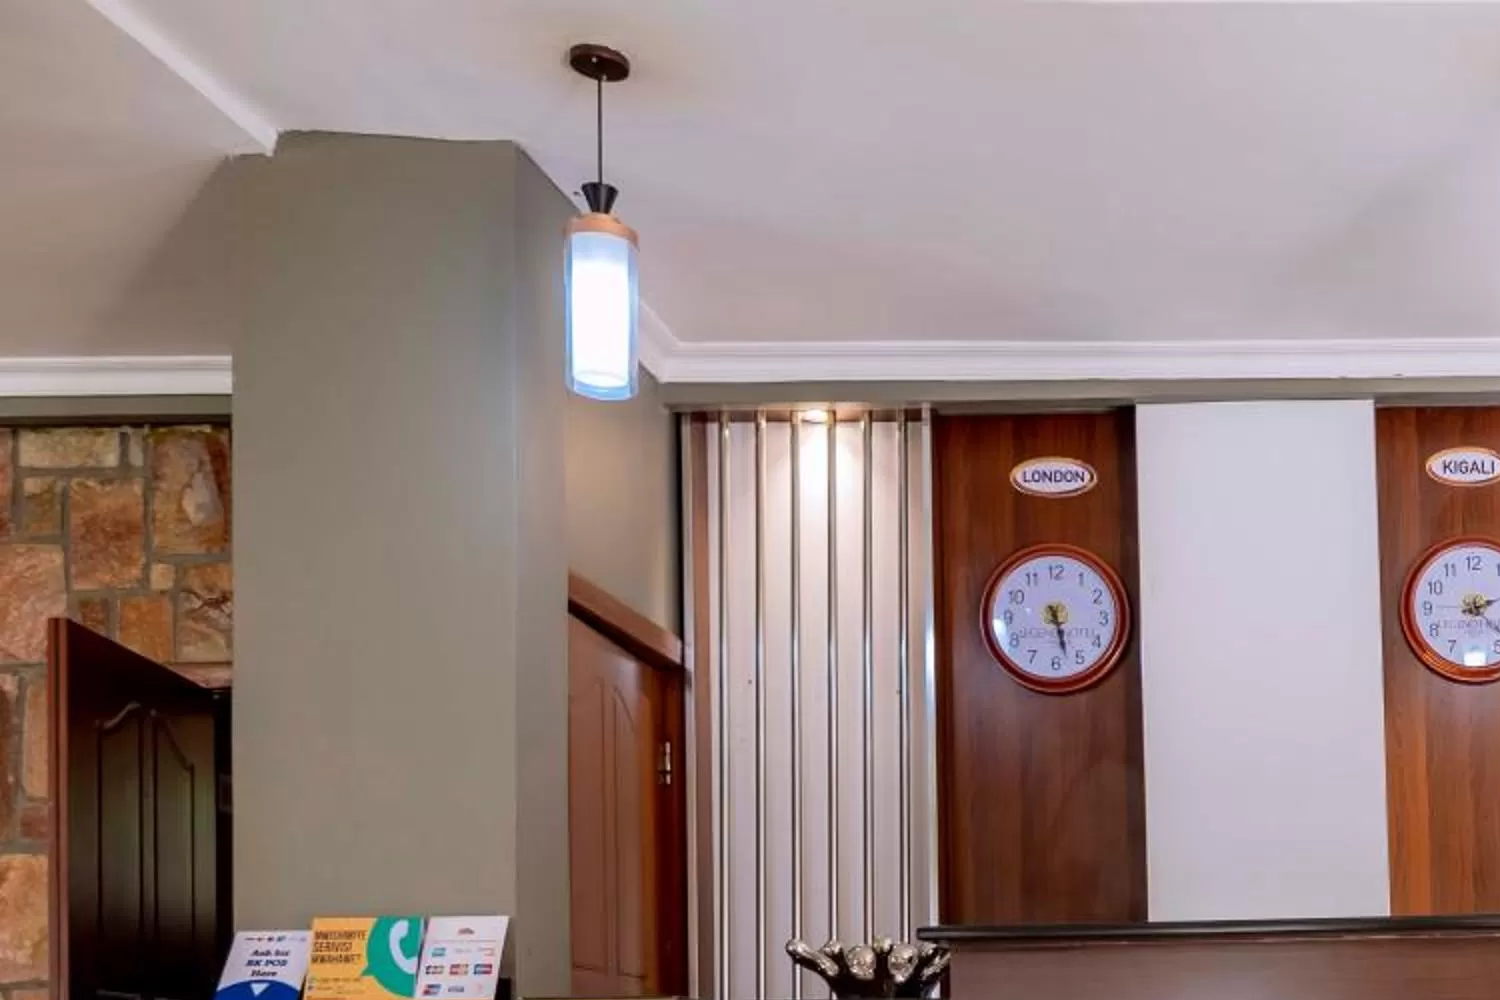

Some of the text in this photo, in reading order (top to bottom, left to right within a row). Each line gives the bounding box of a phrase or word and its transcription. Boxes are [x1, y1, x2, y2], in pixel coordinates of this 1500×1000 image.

[1442, 459, 1496, 475] KIGALI
[1022, 469, 1086, 483] LONDON
[1443, 563, 1457, 578] 11
[1465, 555, 1482, 571] 12
[1025, 572, 1039, 587] 11
[1048, 564, 1065, 581] 12
[1077, 572, 1085, 587] 1
[1091, 588, 1103, 605] 2
[1427, 581, 1443, 596] 10
[1009, 588, 1025, 606] 10
[1422, 600, 1433, 616] 9
[1003, 609, 1014, 625] 9
[1099, 610, 1110, 626] 3
[1008, 632, 1020, 648] 8
[1447, 639, 1457, 654] 7
[1027, 649, 1038, 664] 7
[1050, 656, 1061, 671] 6
[1075, 649, 1086, 665] 5
